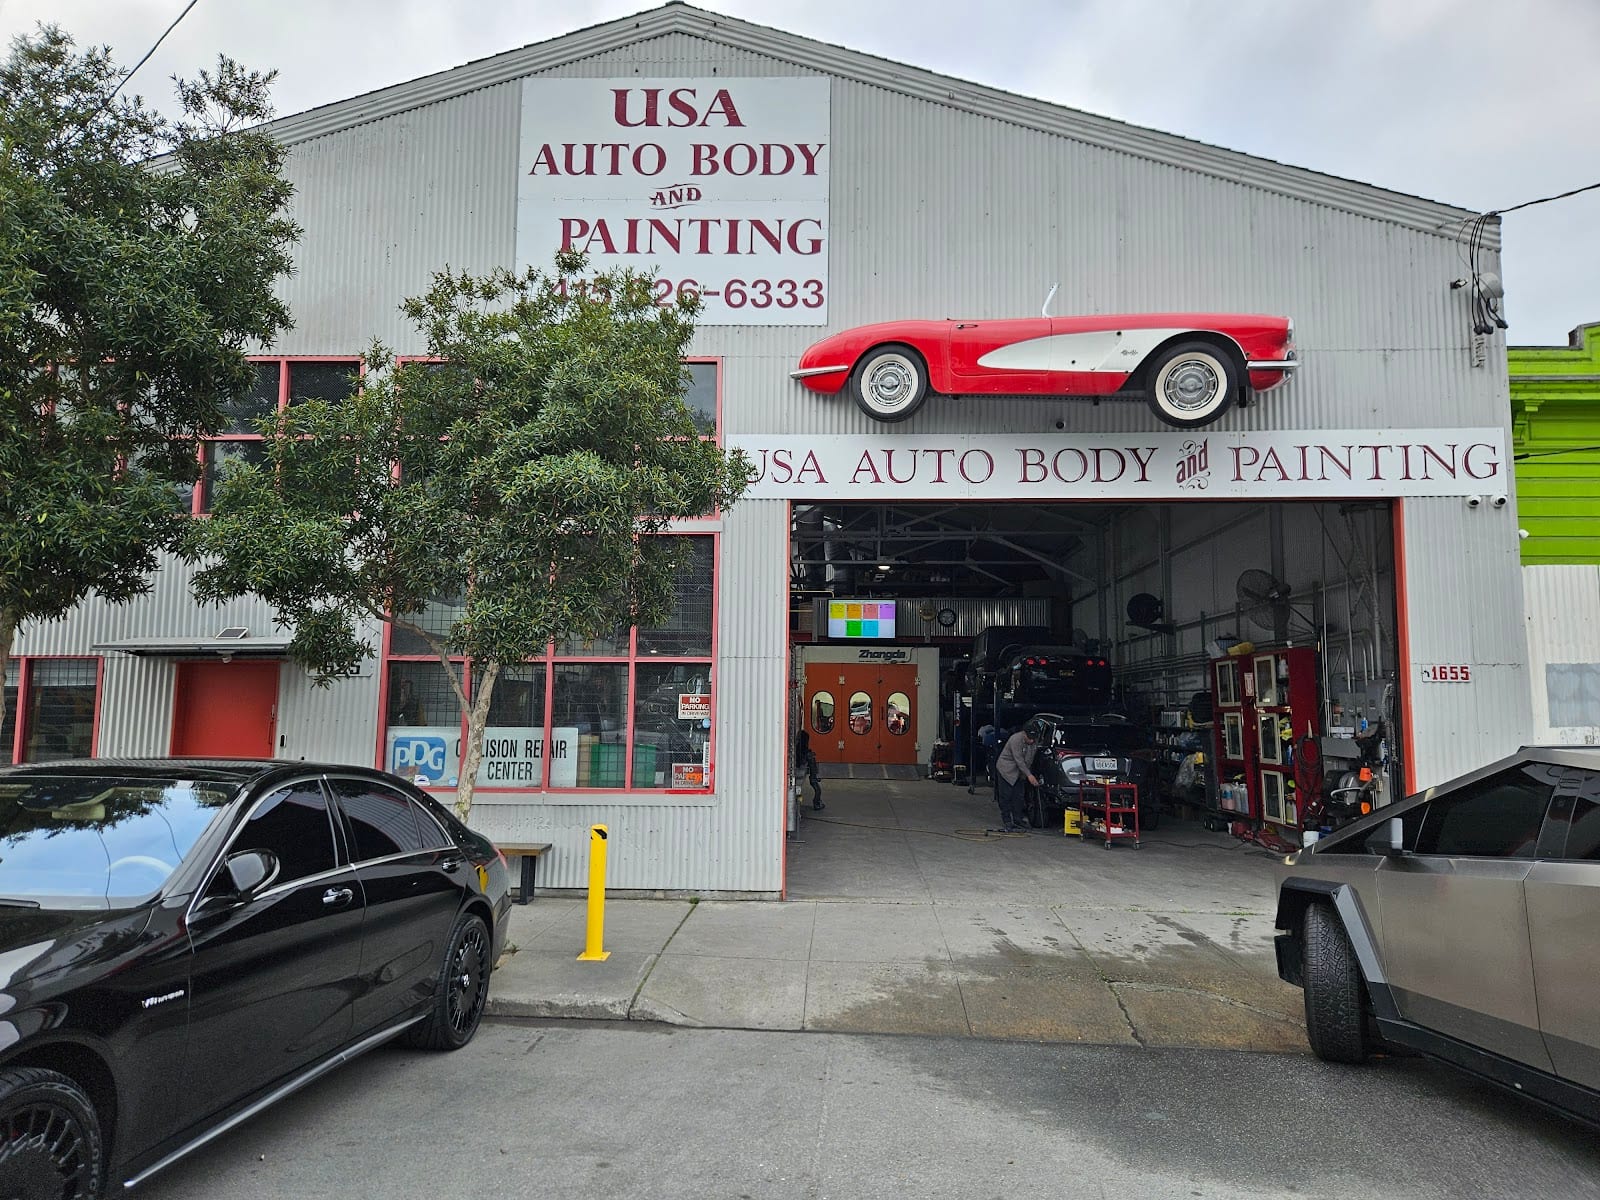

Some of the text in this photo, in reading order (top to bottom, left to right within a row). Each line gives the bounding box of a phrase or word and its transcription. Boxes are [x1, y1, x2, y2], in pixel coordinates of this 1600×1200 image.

[610, 87, 747, 127] USA
[527, 142, 827, 176] AUTO BODY
[650, 187, 702, 206] AND
[558, 218, 825, 255] PAINTING
[626, 277, 825, 309] 26-6333
[736, 437, 1500, 485] USA AUTO BODY and PAINTING
[858, 649, 906, 661] Zhangda
[1431, 666, 1470, 681] 1655
[689, 696, 701, 704] NO
[394, 740, 445, 771] PPG
[456, 738, 518, 758] CISION
[487, 761, 533, 780] CENTER
